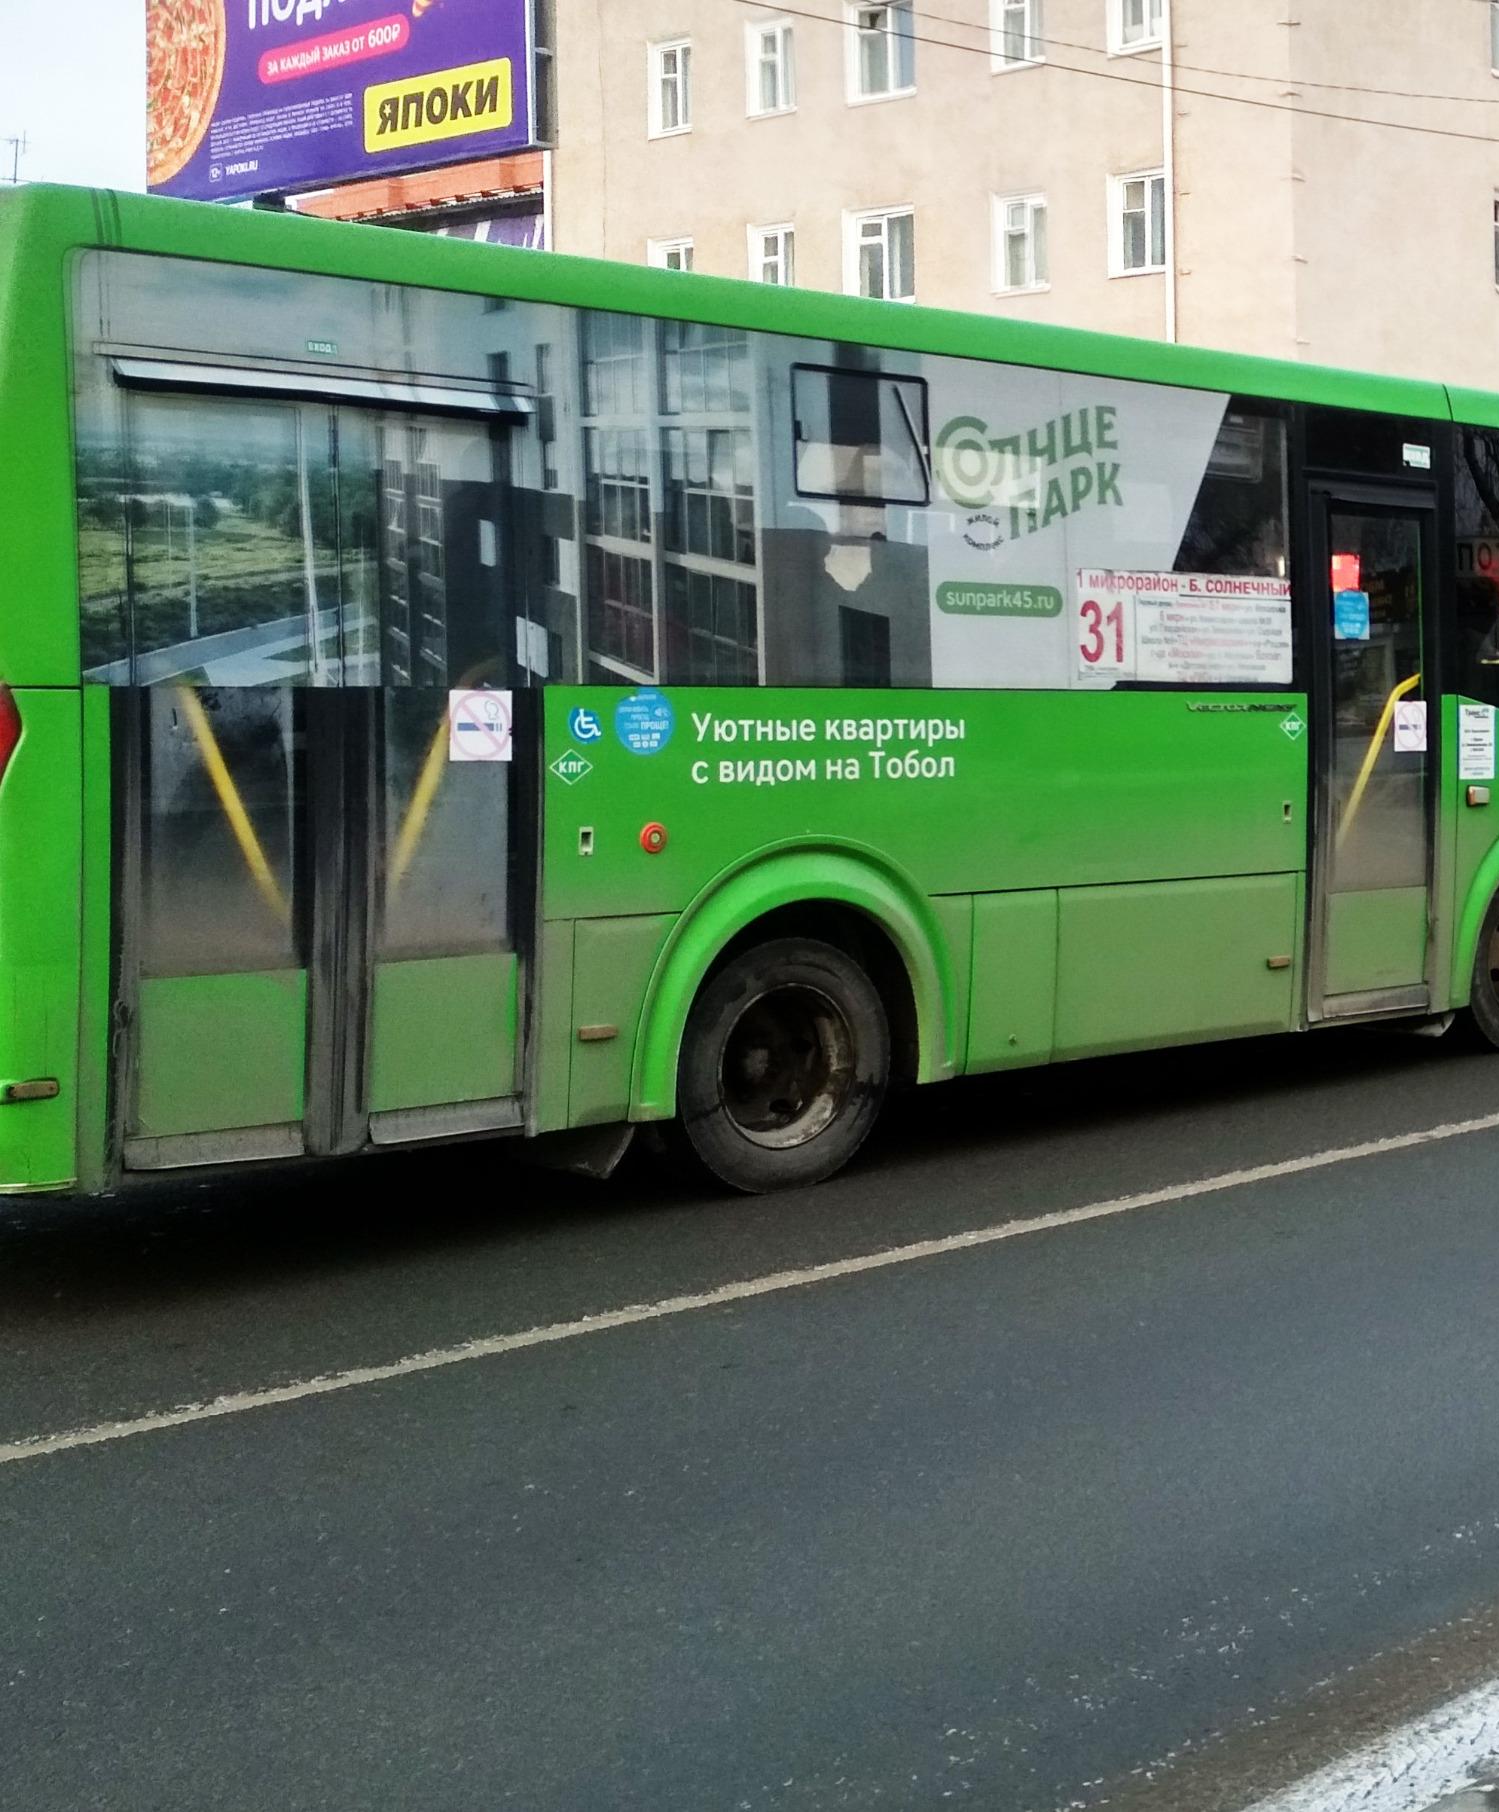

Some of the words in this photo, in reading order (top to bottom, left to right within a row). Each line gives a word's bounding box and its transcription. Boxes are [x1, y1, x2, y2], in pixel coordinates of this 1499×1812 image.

[267, 60, 279, 76] ЗА
[280, 45, 320, 71] КАЖДЫЙ
[322, 40, 350, 62] ЗАКАЗ
[351, 35, 364, 53] ОТ
[375, 75, 499, 135] ЯПОКИ
[1010, 462, 1123, 540] ПАРК
[945, 590, 1055, 611] sunpark45.ru
[1089, 572, 1178, 594] микрорайон
[1189, 579, 1201, 592] Б.
[1080, 599, 1124, 663] 31
[691, 712, 817, 742] Уютные
[825, 719, 965, 747] квартиры
[558, 760, 585, 774] КПГ
[691, 760, 709, 784] с
[719, 759, 817, 786] видом
[826, 757, 860, 780] на
[868, 750, 955, 780] Тобол
